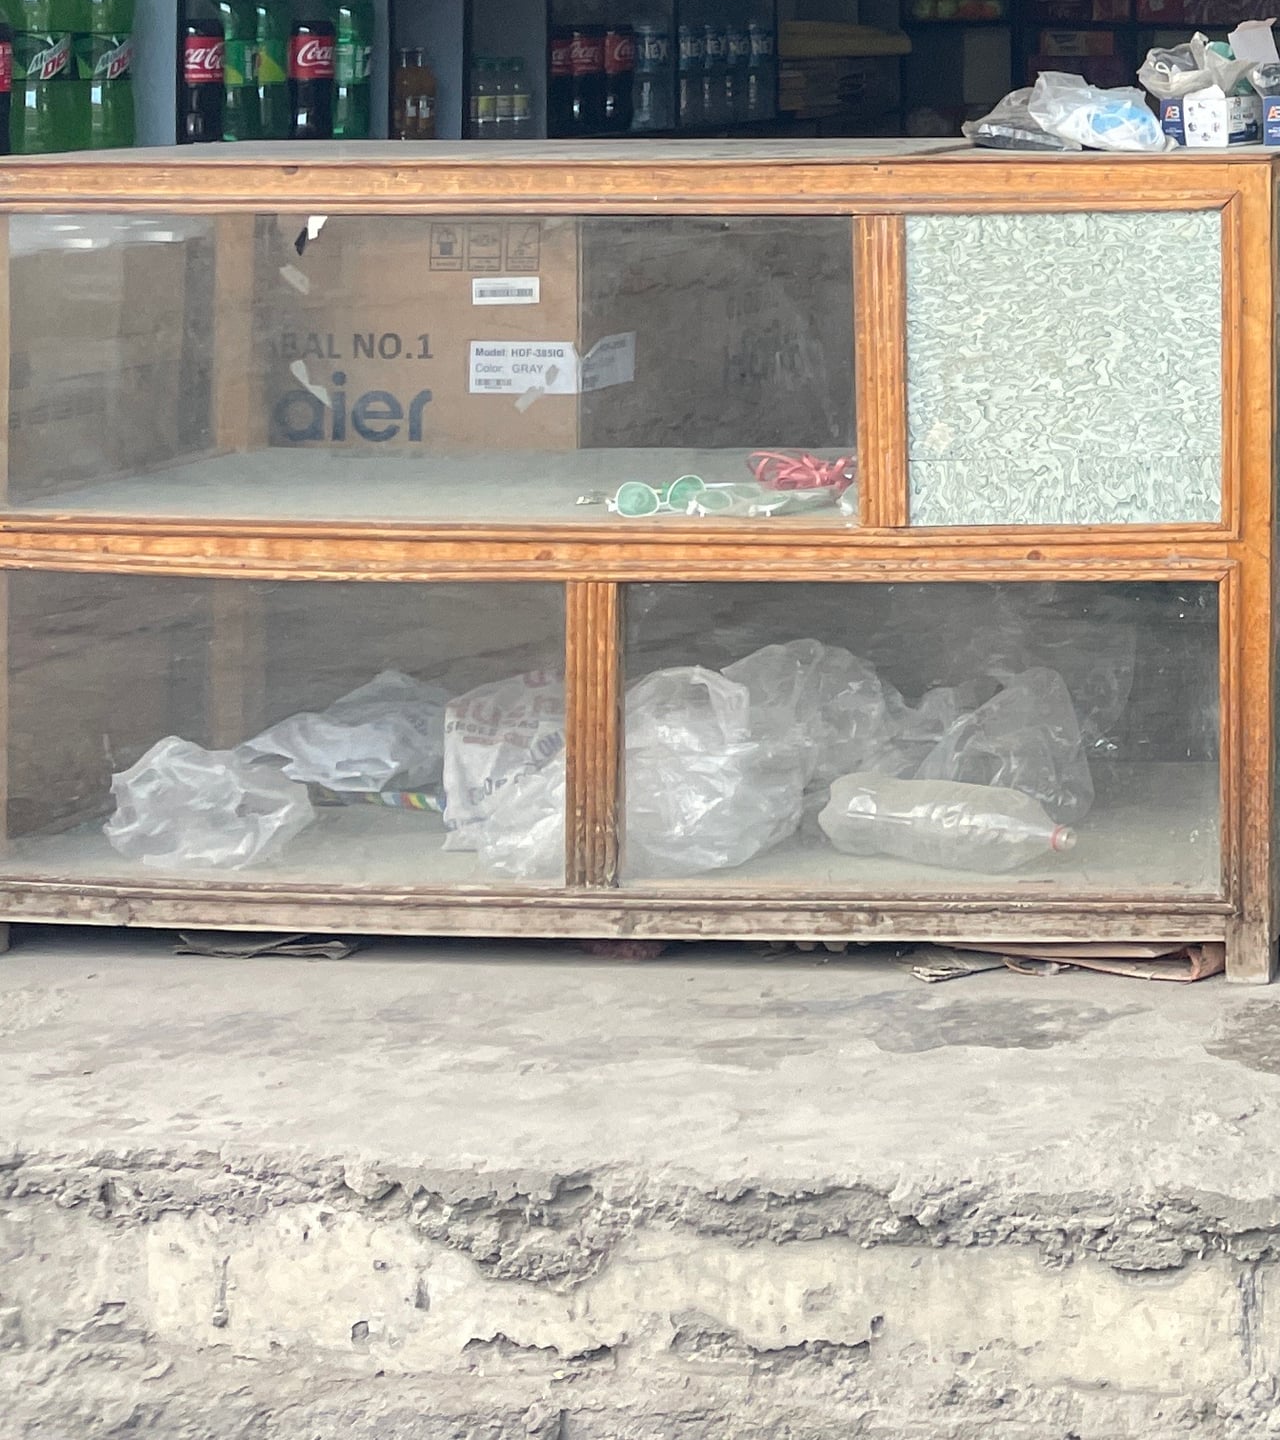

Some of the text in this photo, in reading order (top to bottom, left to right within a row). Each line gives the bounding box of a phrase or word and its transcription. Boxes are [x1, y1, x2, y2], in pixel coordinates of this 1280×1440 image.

[353, 333, 433, 359] NO.1
[512, 363, 544, 374] GRAY
[271, 371, 433, 442] aier
